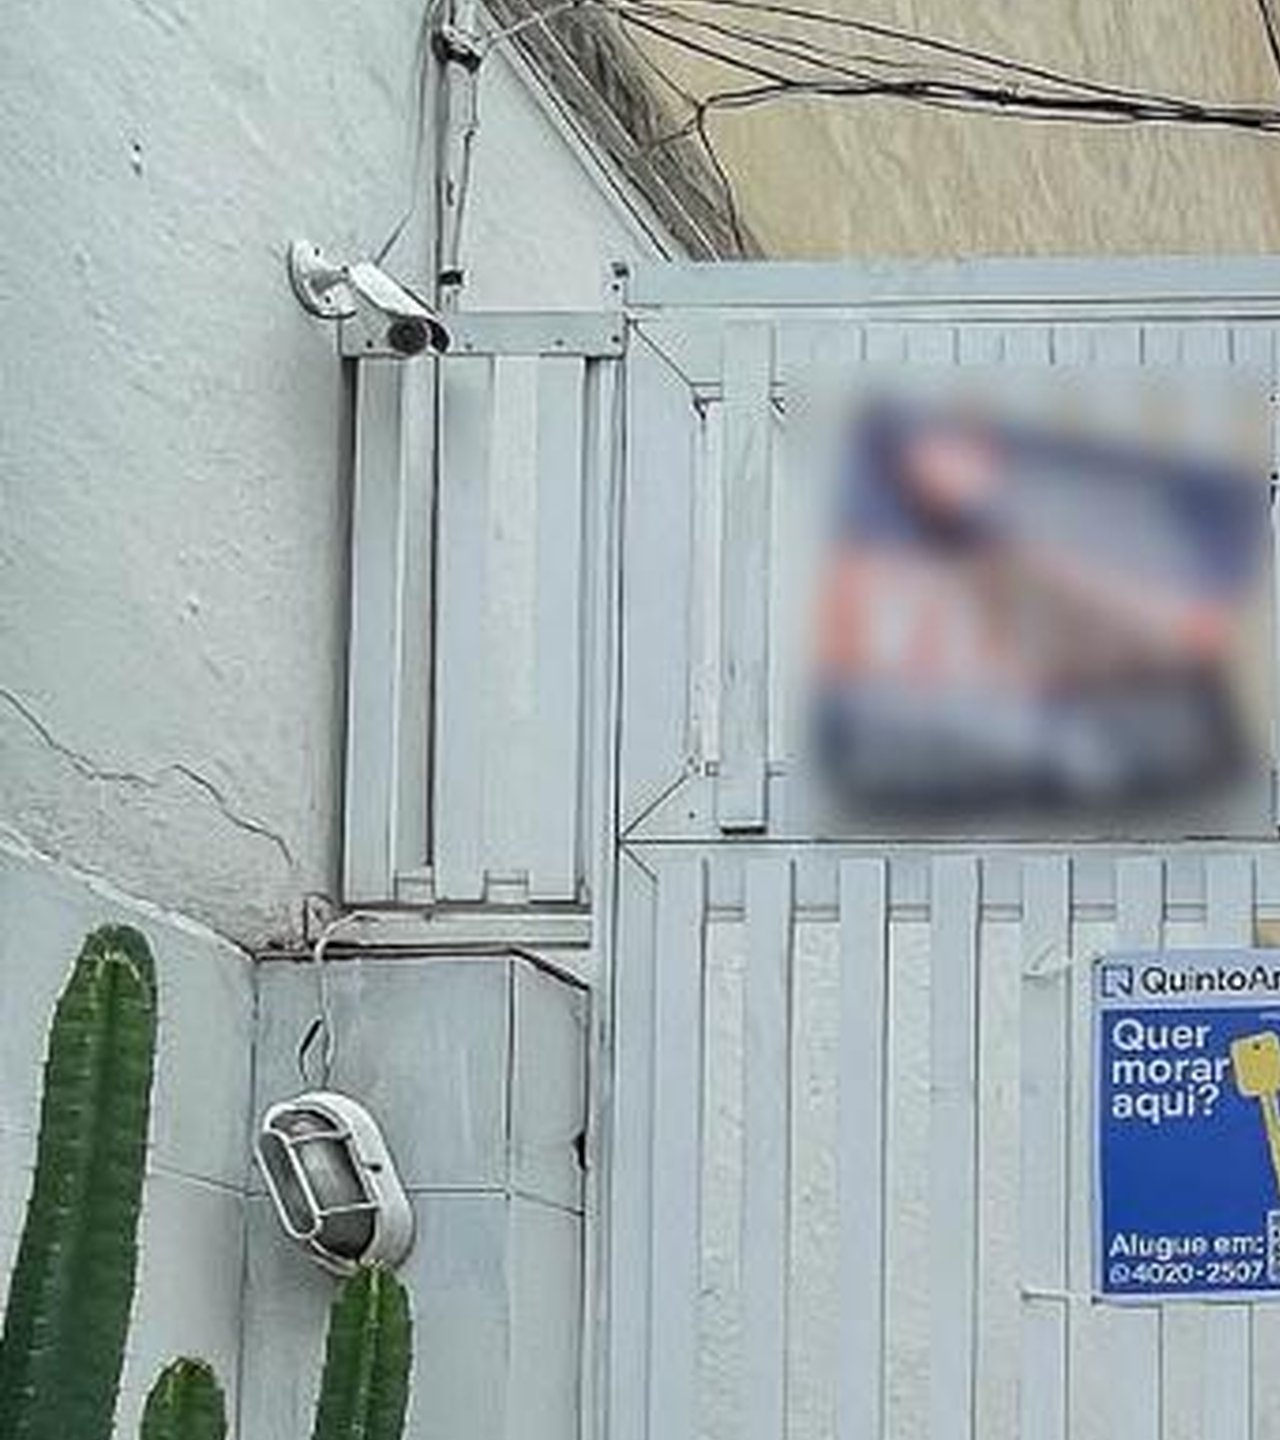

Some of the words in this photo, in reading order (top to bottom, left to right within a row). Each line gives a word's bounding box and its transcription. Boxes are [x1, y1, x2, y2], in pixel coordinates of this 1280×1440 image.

[1112, 1018, 1211, 1051] Quer
[1112, 1057, 1231, 1084] morar
[1112, 1083, 1220, 1125] aqui?
[1109, 1232, 1208, 1261] Alugue
[1214, 1236, 1265, 1255] em:
